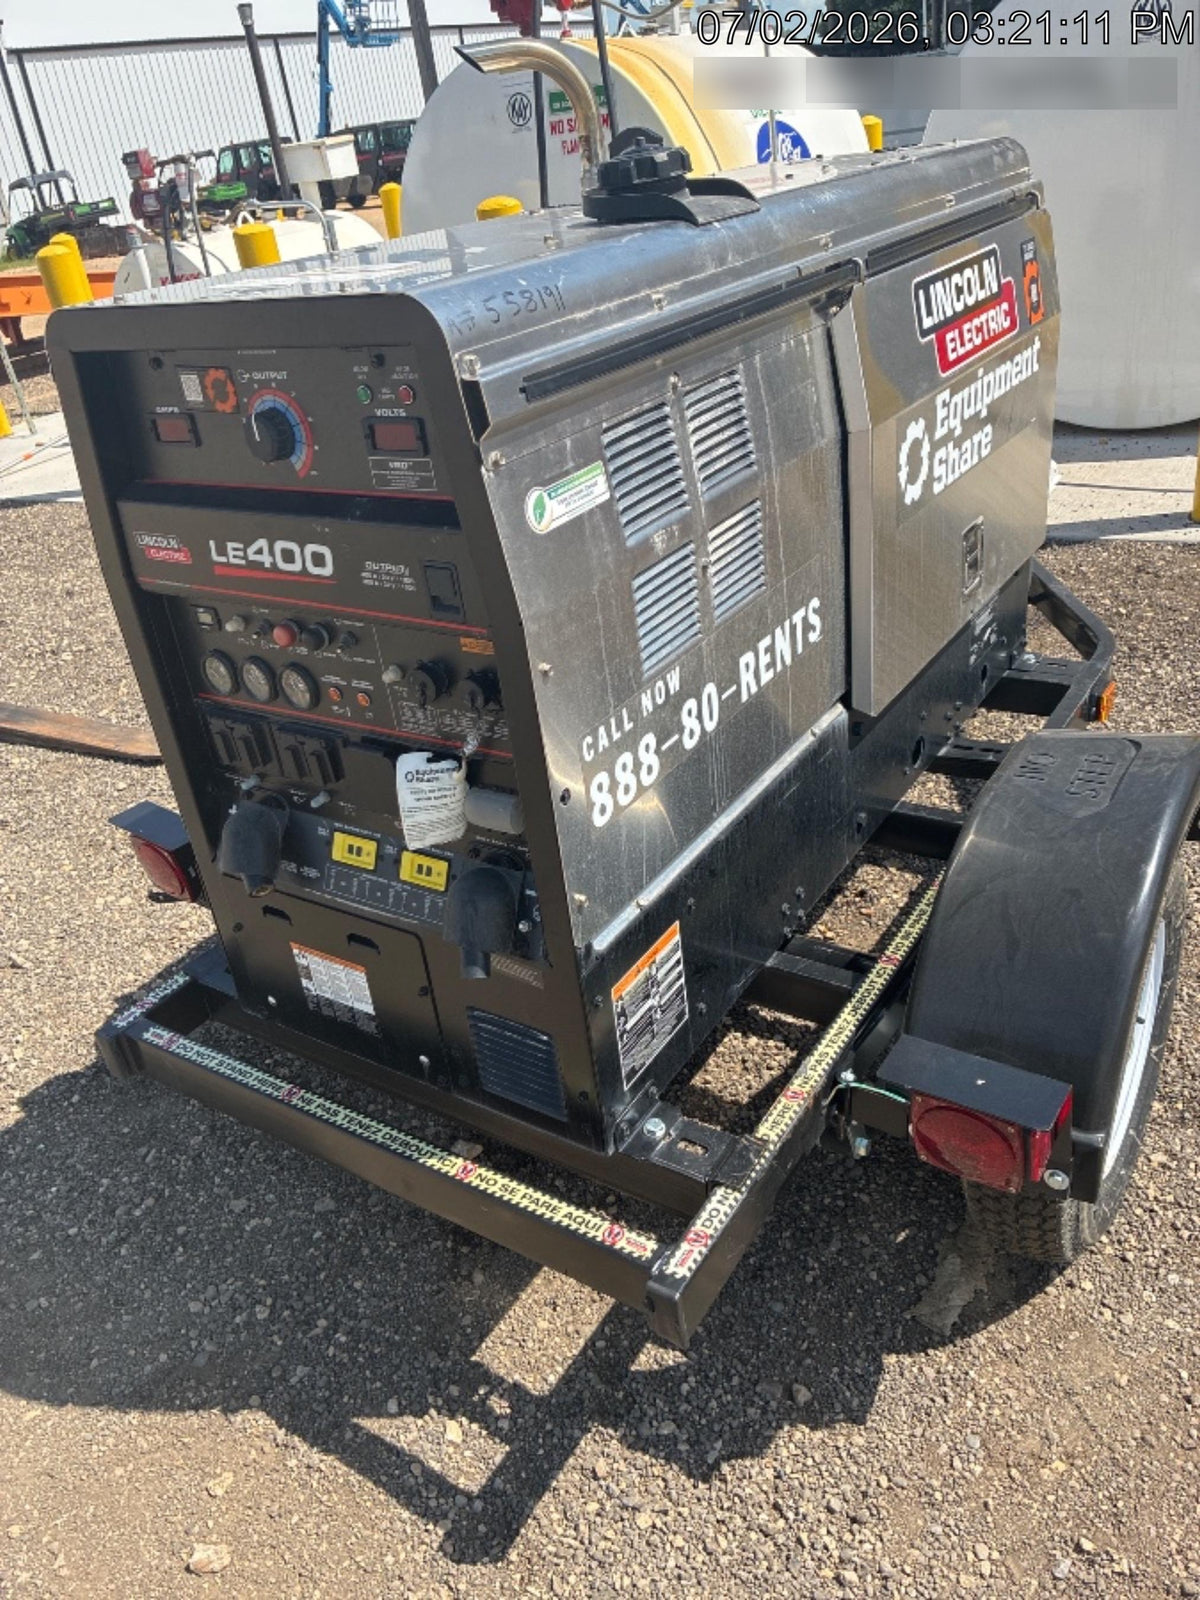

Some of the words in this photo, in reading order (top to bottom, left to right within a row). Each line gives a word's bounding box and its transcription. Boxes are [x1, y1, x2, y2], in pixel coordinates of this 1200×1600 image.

[918, 256, 999, 329] LINCOLN
[946, 302, 1011, 362] ELECTRIC
[374, 408, 407, 417] VOLTS
[934, 335, 1041, 441] Equipment
[933, 423, 993, 495] Share
[208, 538, 334, 577] LE400
[582, 706, 633, 762] CALL
[640, 666, 680, 717] NOW
[590, 597, 822, 827] 888-80-RENTS
[216, 1059, 254, 1079] STAND
[800, 1074, 814, 1089] NE
[810, 1051, 830, 1073] PAS
[827, 1017, 852, 1050] TENEZ
[315, 1102, 339, 1117] PAS
[342, 1113, 380, 1137] TENEZ
[770, 1102, 794, 1132] HERE
[475, 1172, 497, 1187] NO
[499, 1183, 519, 1197] SE
[520, 1192, 561, 1216] PARE
[702, 1207, 721, 1229] DO
[720, 1187, 735, 1206] NO
